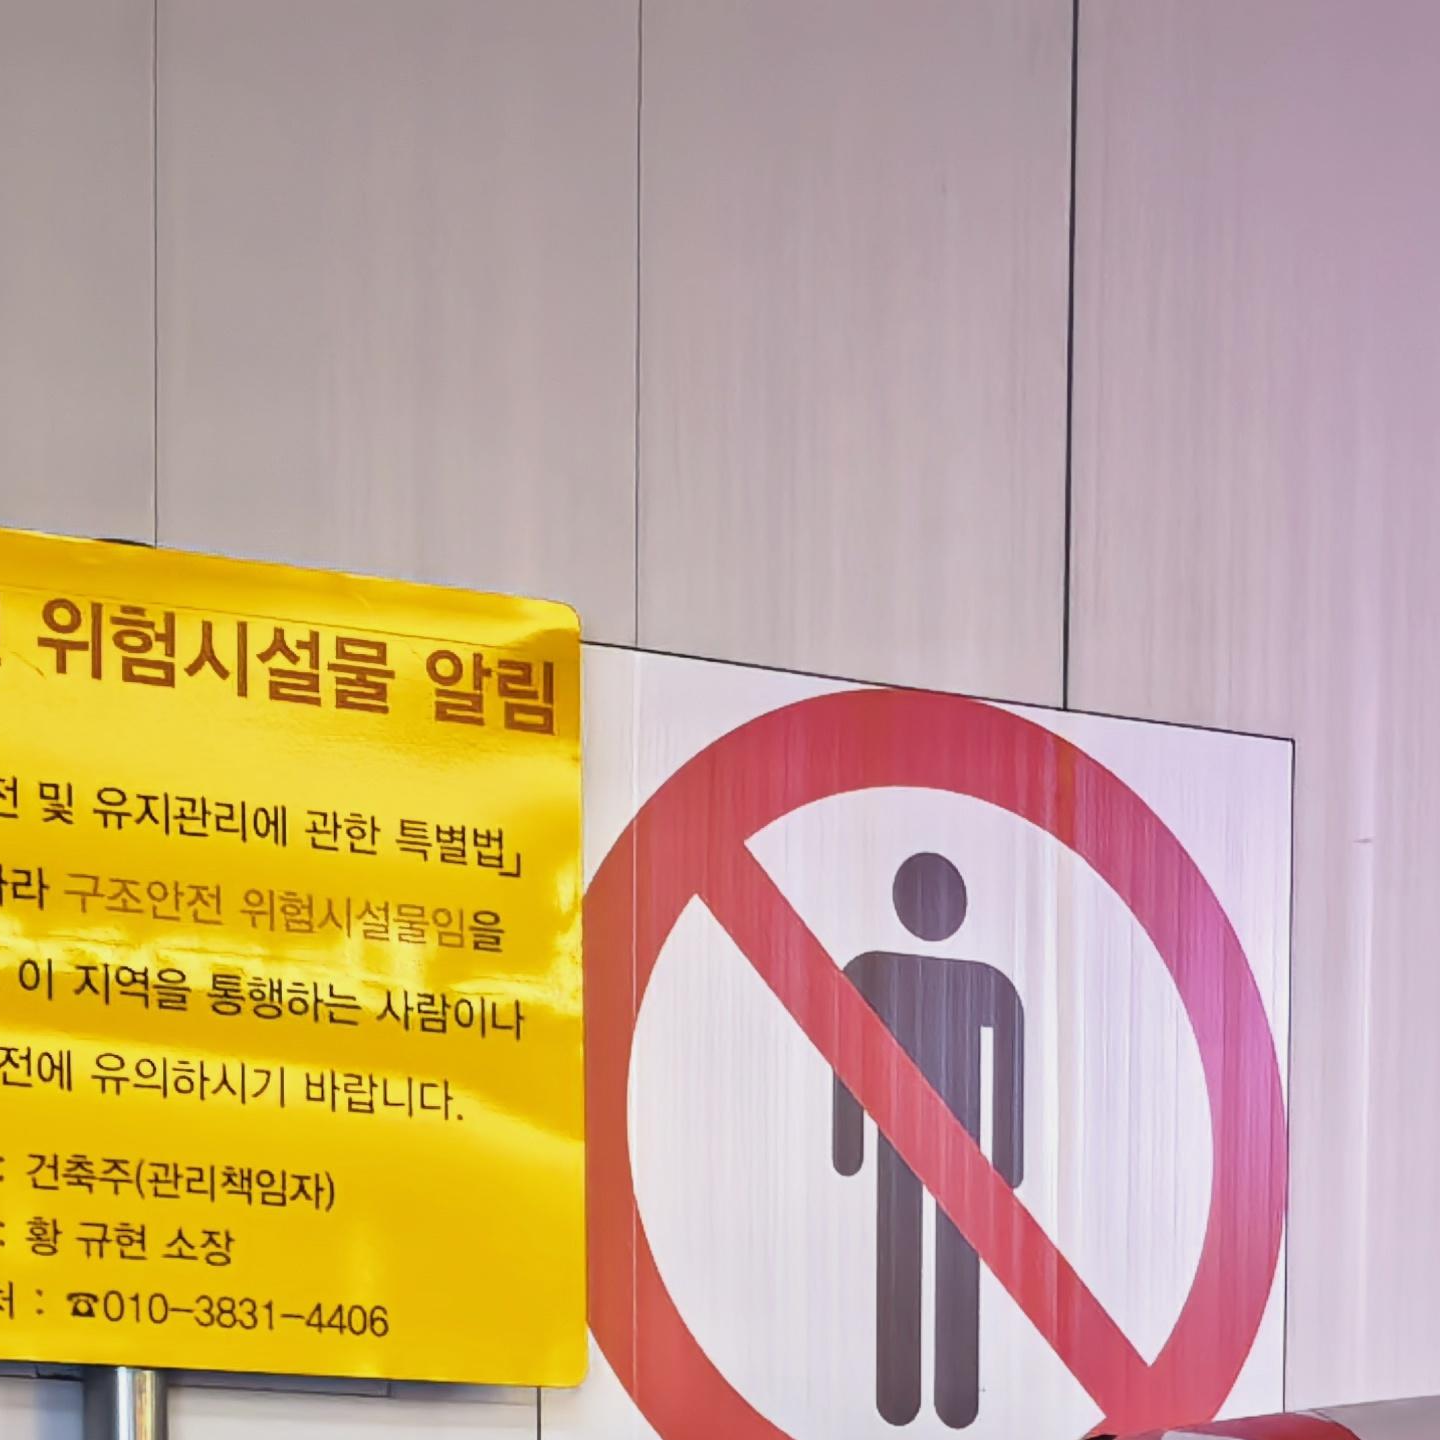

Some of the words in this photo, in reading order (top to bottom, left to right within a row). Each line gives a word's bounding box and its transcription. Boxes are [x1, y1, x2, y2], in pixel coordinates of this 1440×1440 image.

[37, 597, 395, 716] 위험시설물
[425, 644, 556, 736] 알림
[38, 782, 74, 825] 및
[93, 786, 288, 847] 유지관리에
[306, 808, 381, 857] 관한
[64, 869, 222, 928] 구조안전
[242, 880, 504, 953] 위험시설물임을
[19, 958, 54, 996] 이
[74, 961, 190, 1012] 지역을
[208, 975, 362, 1028] 통행하는
[378, 988, 524, 1042] 사람이나
[92, 1052, 287, 1111] 유의하시기
[305, 1071, 464, 1124] 바랍니다.
[28, 1152, 335, 1211] 건축주(관리책임자)
[26, 1216, 62, 1259] 황
[78, 1222, 149, 1261] 규현
[165, 1227, 235, 1267] 소장
